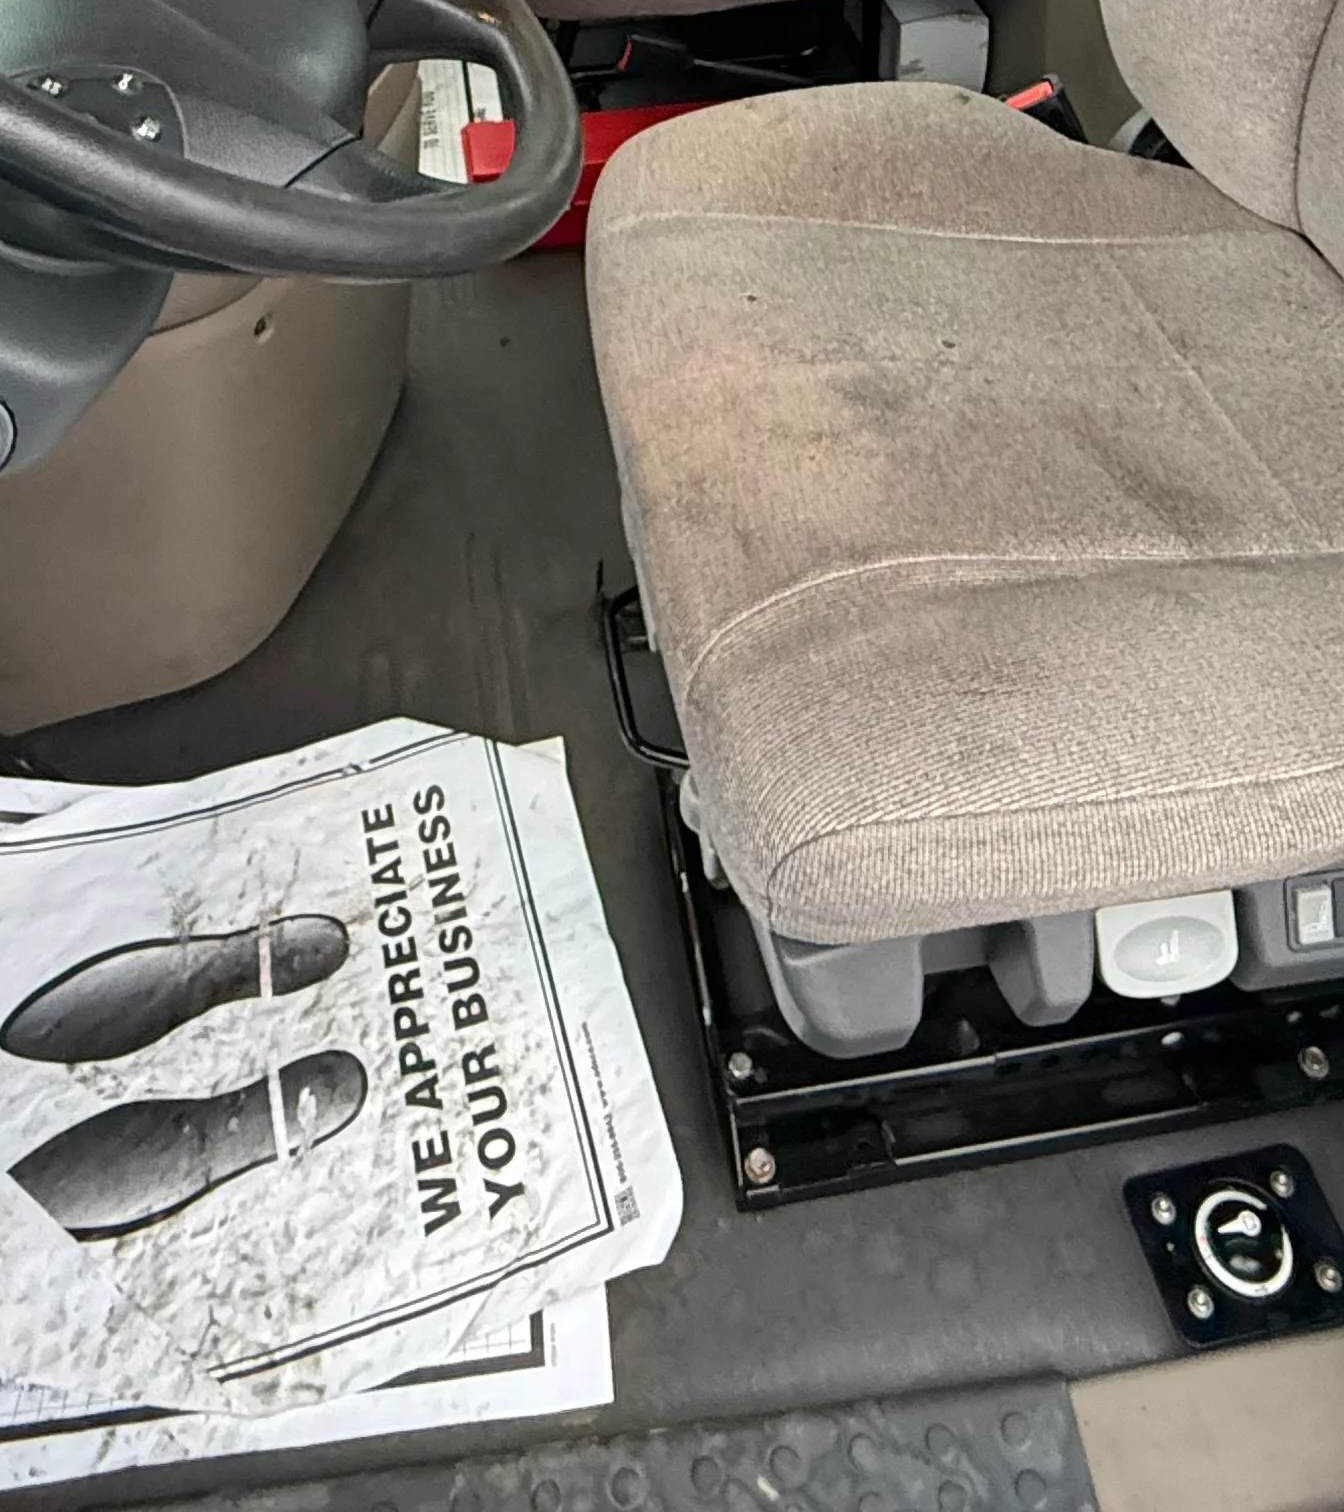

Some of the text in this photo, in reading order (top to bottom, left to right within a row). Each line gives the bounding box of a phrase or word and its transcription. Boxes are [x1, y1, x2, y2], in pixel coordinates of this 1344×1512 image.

[362, 803, 462, 1237] WE APPRECIATE
[413, 784, 526, 1220] YOUR BUSINESS
